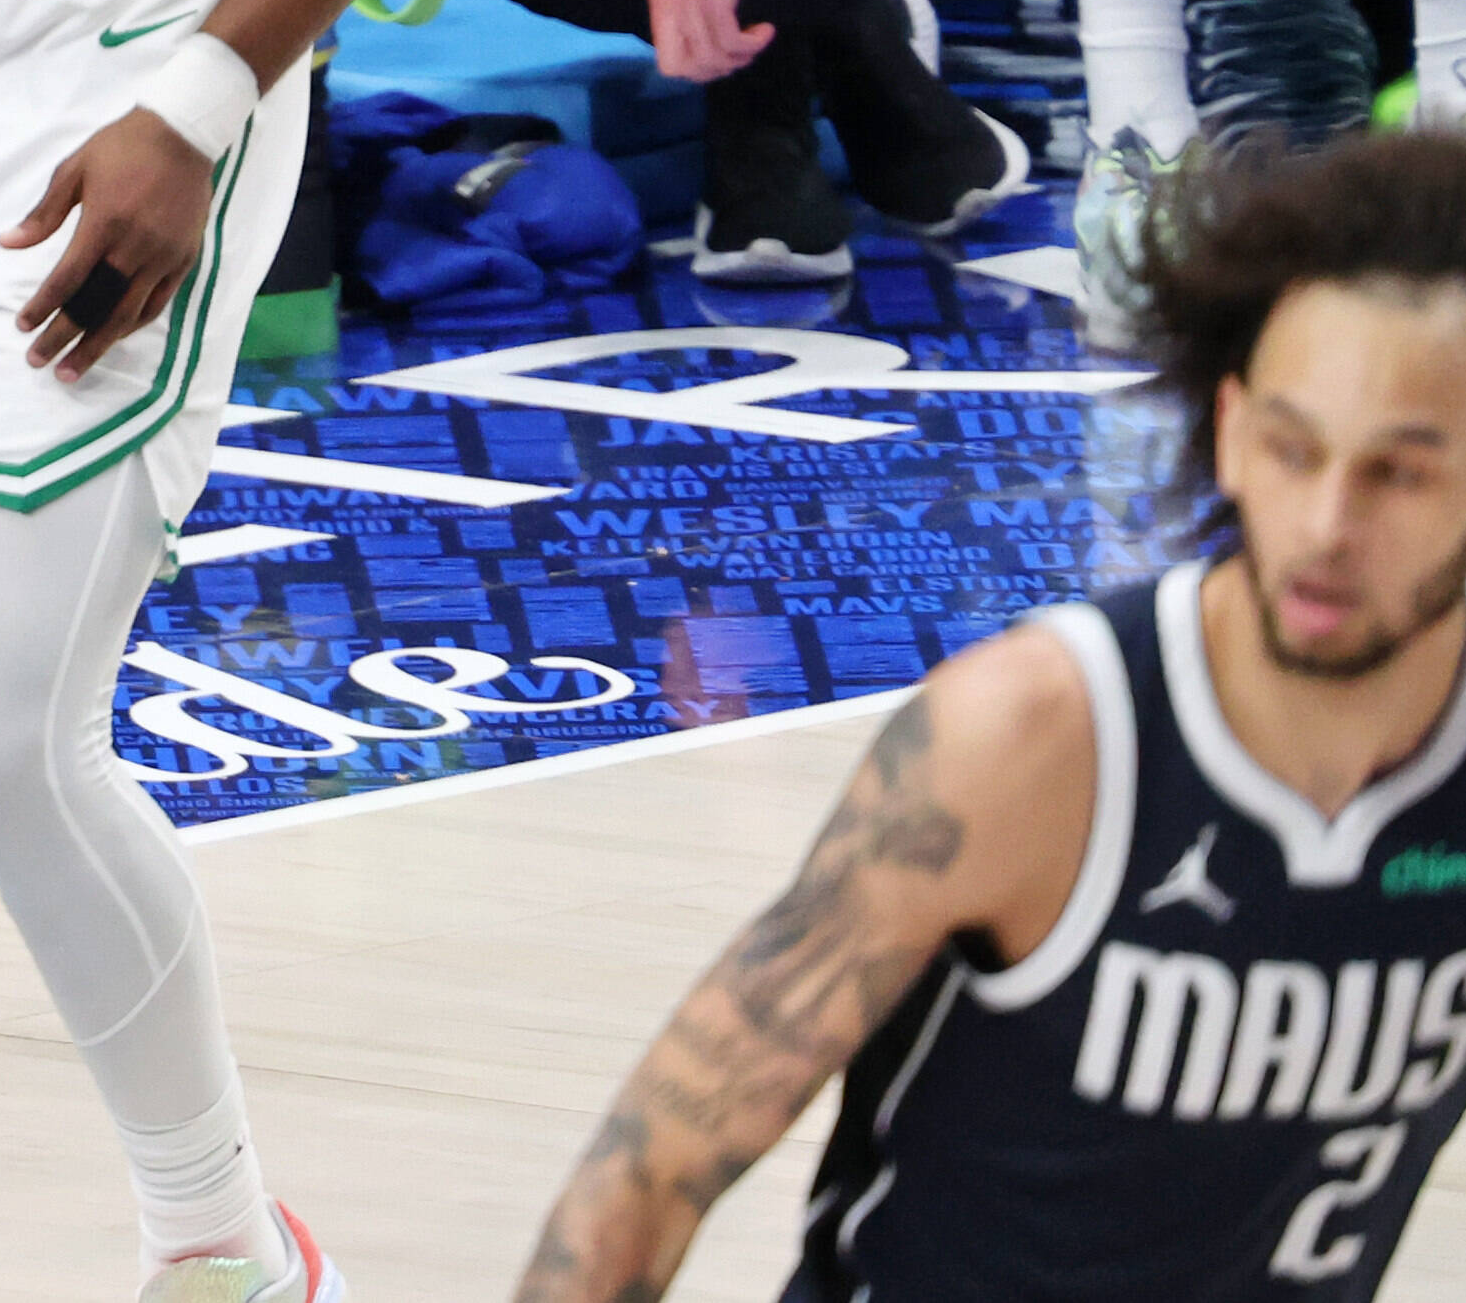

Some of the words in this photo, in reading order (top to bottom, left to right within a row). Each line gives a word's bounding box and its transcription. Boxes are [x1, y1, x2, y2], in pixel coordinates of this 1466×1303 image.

[556, 500, 932, 538] WESLEY
[702, 531, 799, 551] VAN
[782, 593, 945, 615] MAVS
[1073, 939, 1466, 1123] MAVS
[1268, 1118, 1410, 1281] 2
